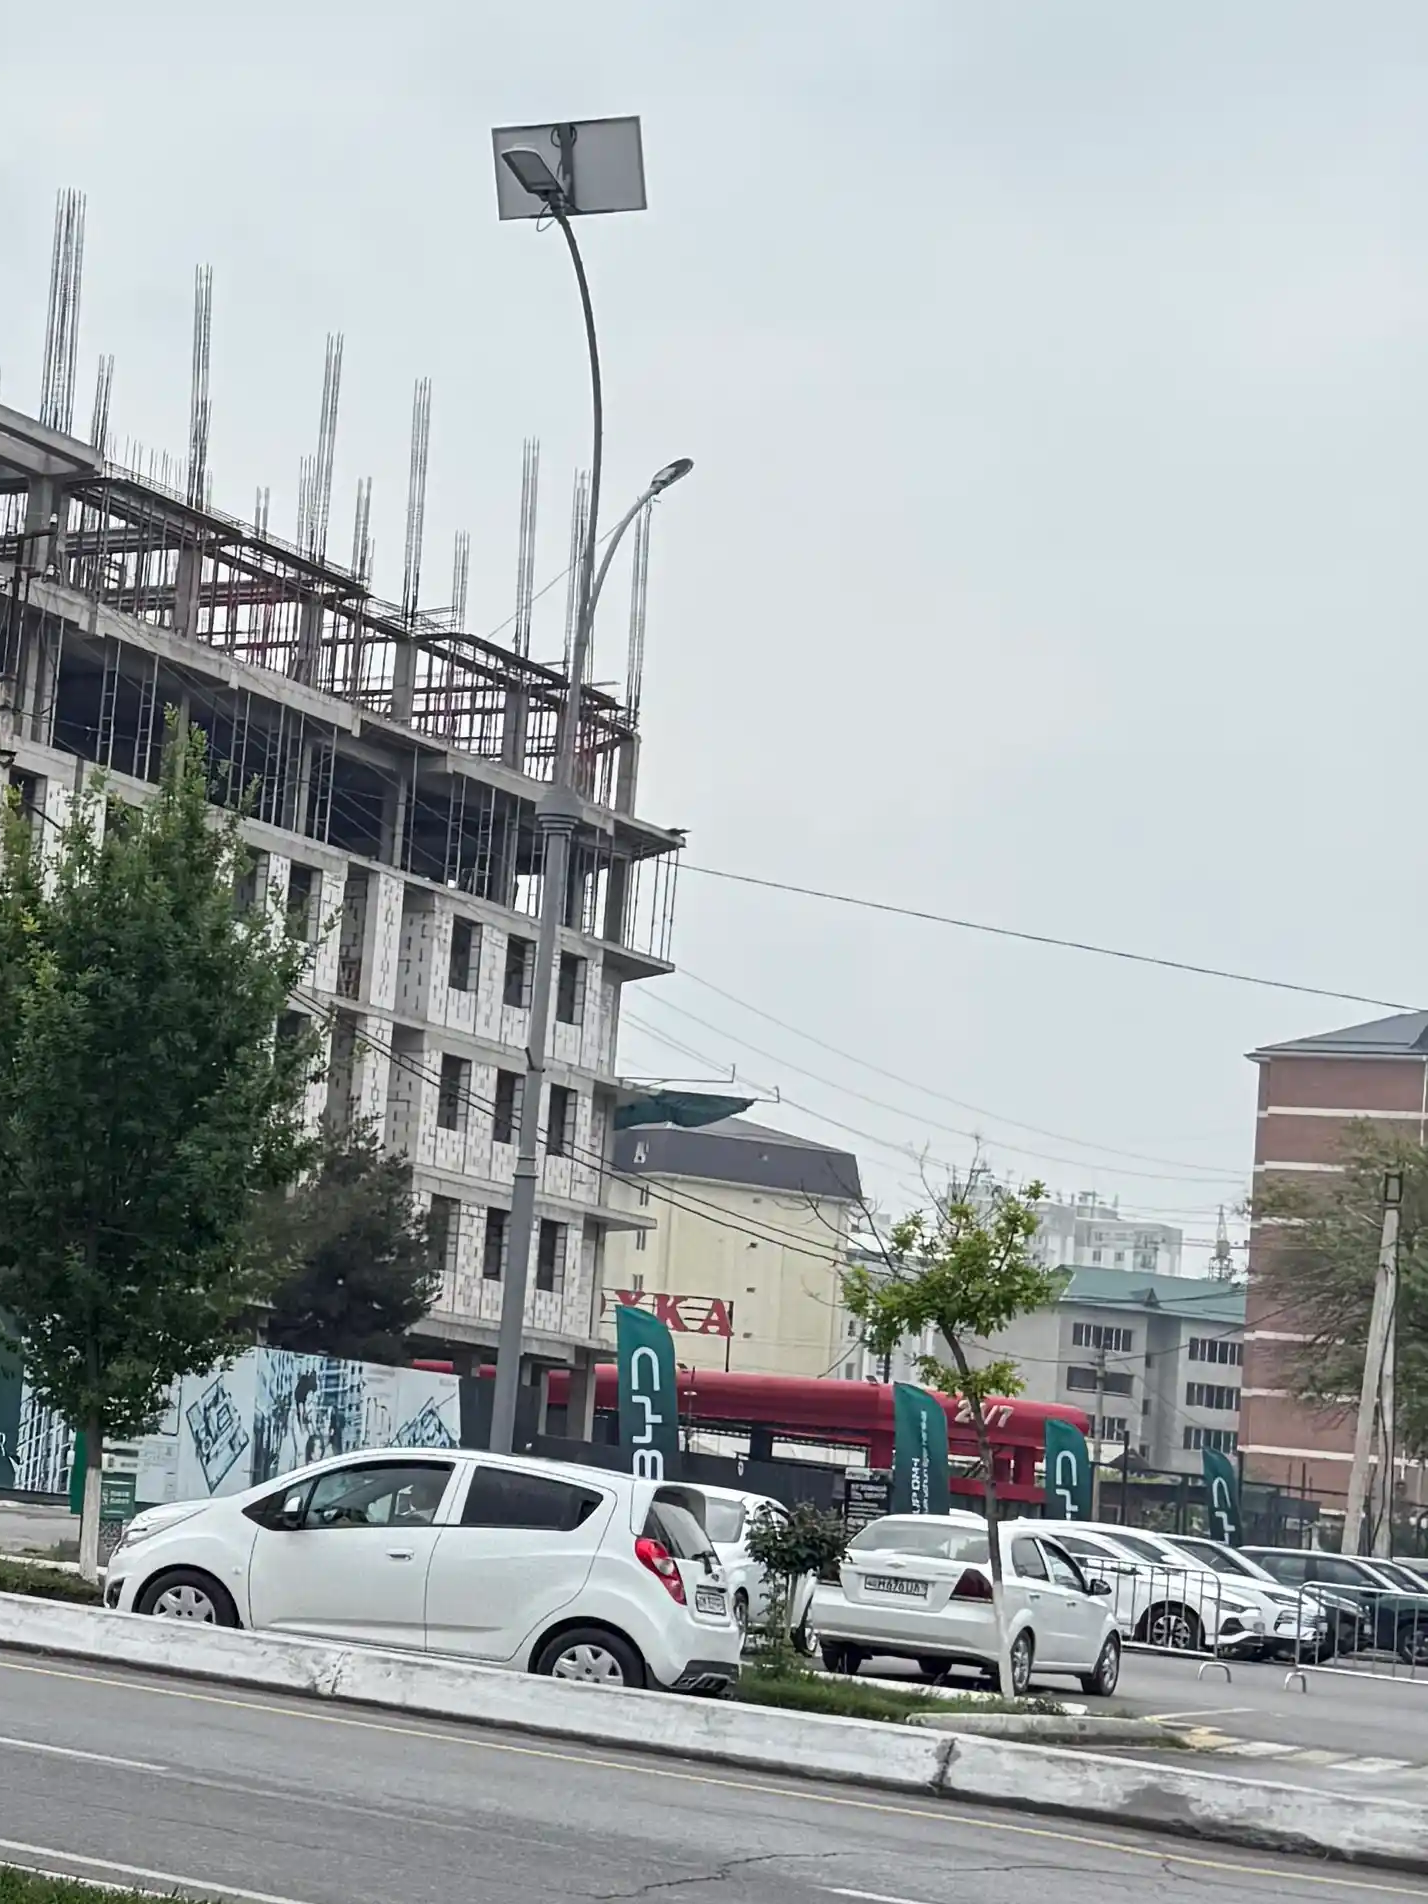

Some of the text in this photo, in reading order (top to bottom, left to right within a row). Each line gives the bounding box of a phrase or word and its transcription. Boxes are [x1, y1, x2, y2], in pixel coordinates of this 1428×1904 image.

[631, 1346, 664, 1481] BYD
[954, 1399, 1014, 1428] 2/7
[1056, 1450, 1079, 1520] YD
[1212, 1476, 1236, 1545] YD
